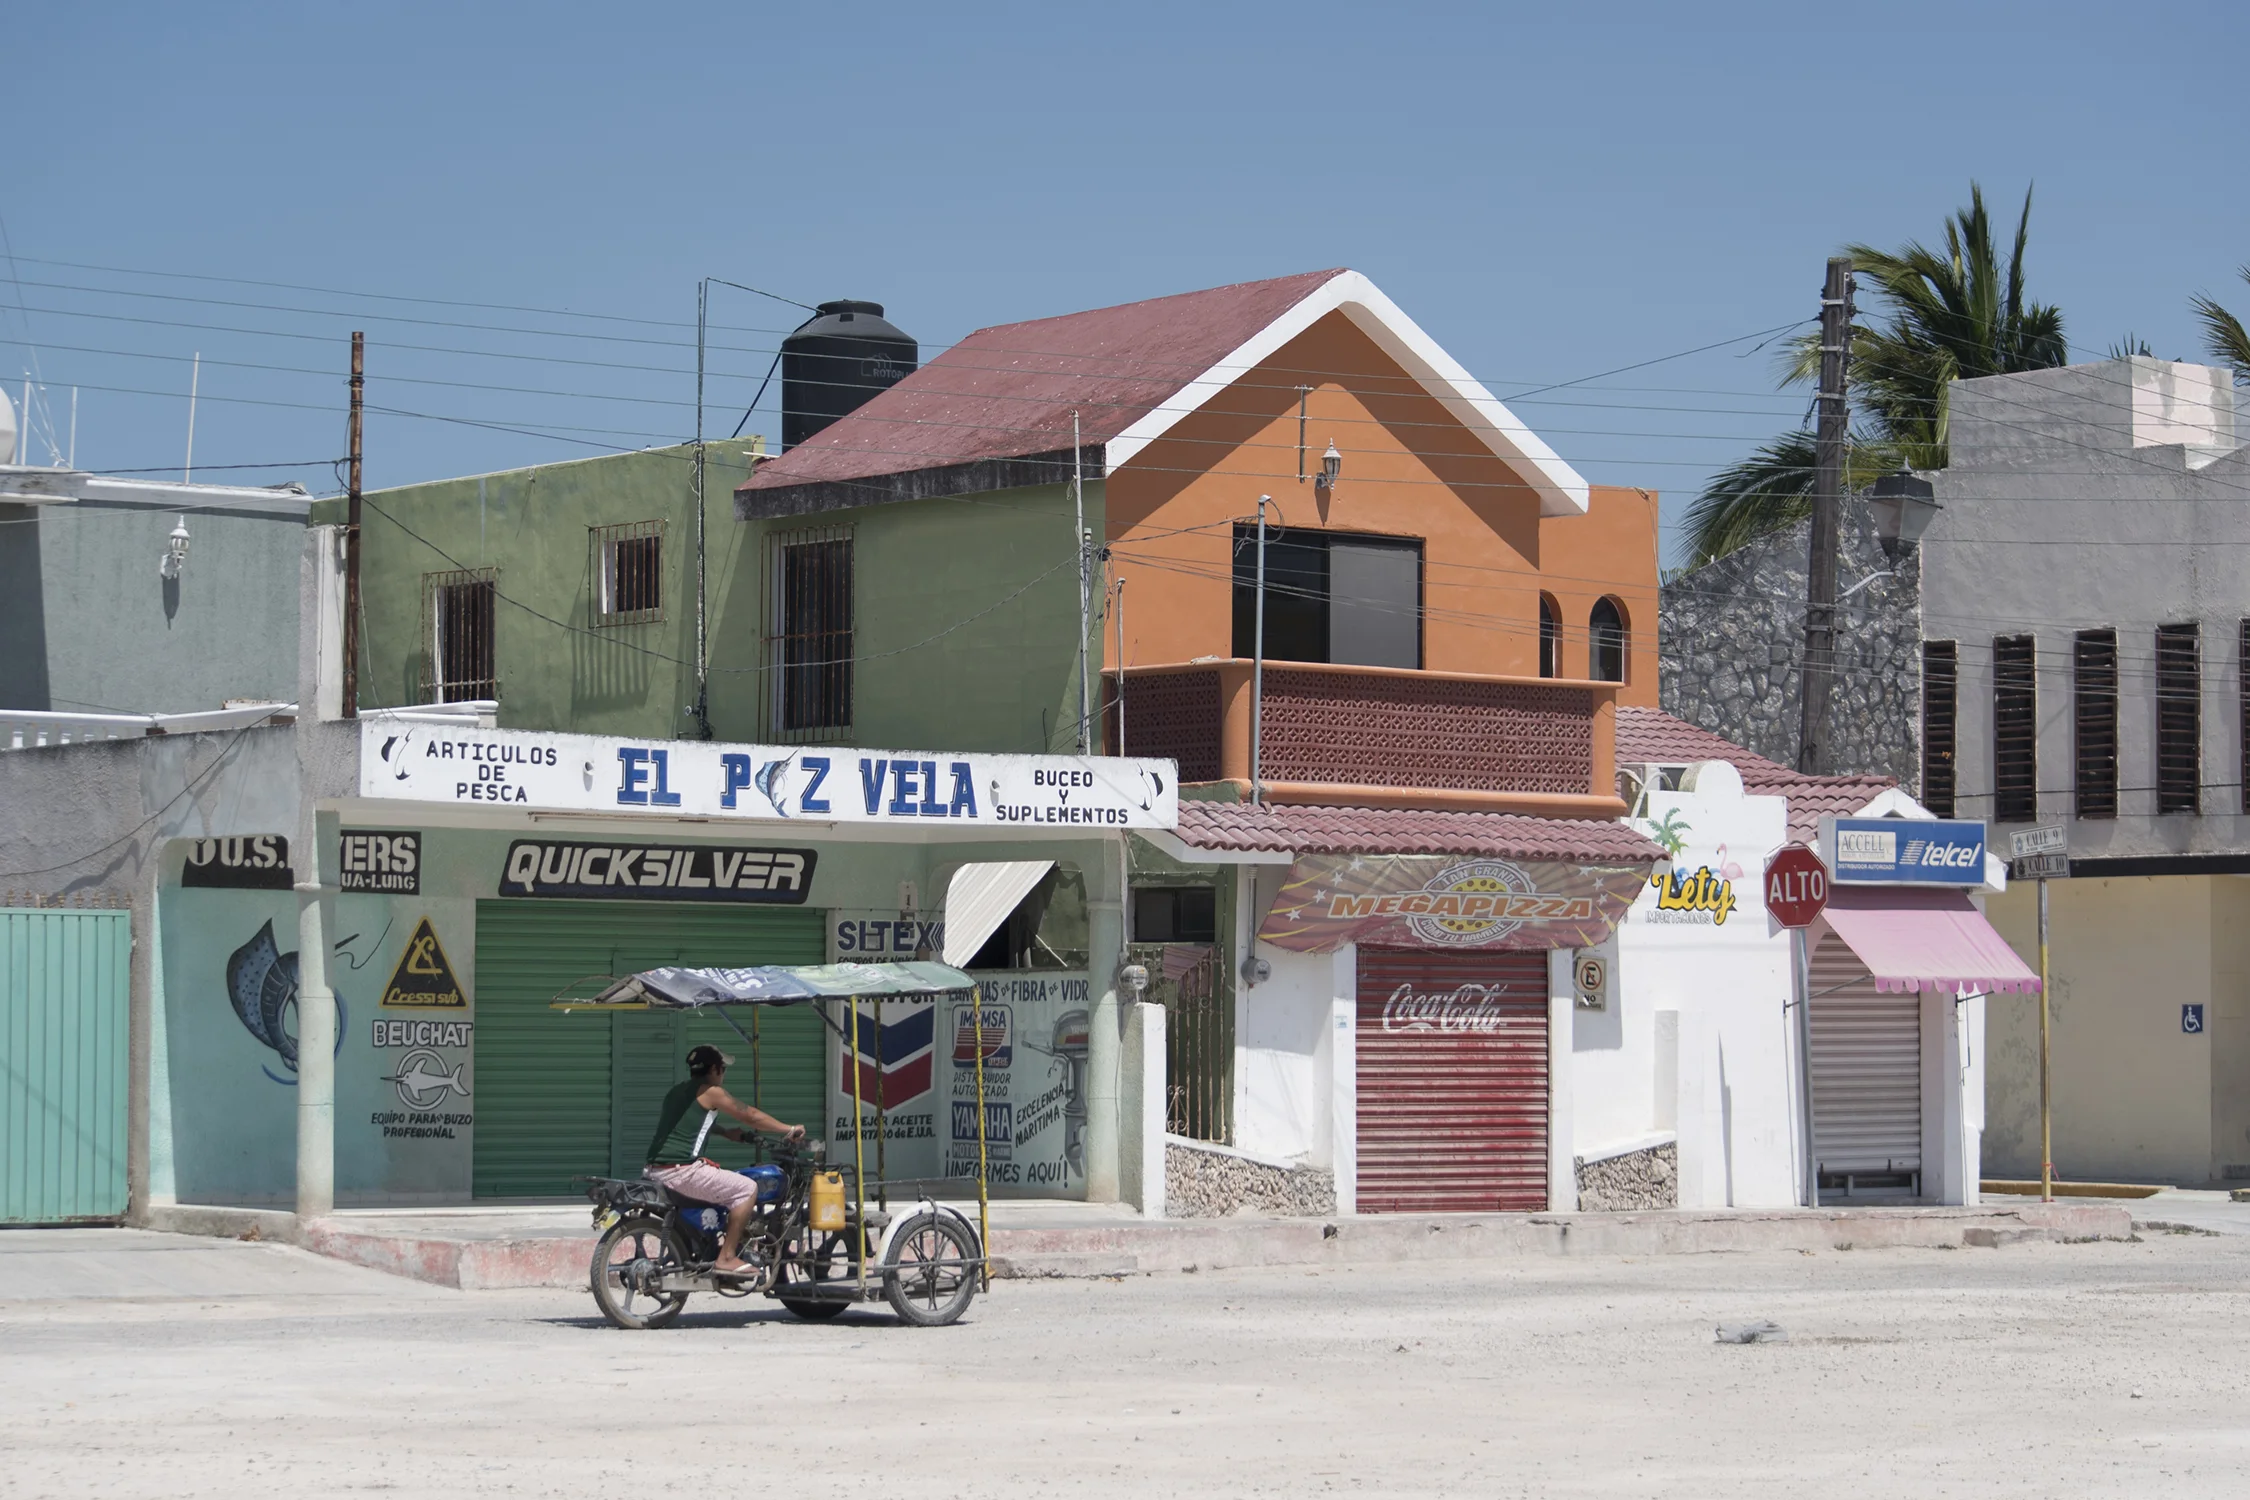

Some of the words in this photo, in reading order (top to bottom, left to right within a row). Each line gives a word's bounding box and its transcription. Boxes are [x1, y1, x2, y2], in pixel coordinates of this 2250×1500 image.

[426, 740, 557, 766] ARTICULOS
[478, 764, 505, 781] DE
[617, 747, 681, 807] EL
[859, 758, 978, 817] VELA
[1034, 770, 1093, 787] BUCEO
[456, 783, 528, 802] PESCA
[1058, 789, 1069, 804] Y
[996, 805, 1128, 824] SUPLEMENTOS
[1841, 834, 1884, 851] ACCELL
[2026, 829, 2049, 847] CALLE
[1921, 841, 1982, 867] telcel
[2029, 856, 2051, 871] CALLE
[2055, 856, 2065, 870] 10
[508, 844, 805, 892] QUICKSILVER
[1474, 866, 1522, 888] GRANDE
[1650, 865, 1736, 926] Lety
[1769, 869, 1824, 903] ALTO
[1327, 893, 1592, 919] MEGAPIZZA
[837, 920, 936, 951] SITEX
[1420, 918, 1444, 939] COMO
[1461, 921, 1507, 942] HAMBRE
[1011, 980, 1047, 1001] FIBRA
[960, 1010, 1006, 1027] IMMSA
[372, 1020, 473, 1047] BEUCHAT
[953, 1072, 1011, 1084] DISTRBUIDOR
[1016, 1083, 1064, 1125] EXCELENCIA
[409, 1113, 437, 1124] PARA
[443, 1113, 473, 1124] BUZO
[835, 1117, 849, 1128] EL
[892, 1114, 933, 1126] ACEITE
[953, 1105, 1011, 1139] YAMAHA
[1015, 1105, 1060, 1148] MARITIMA
[952, 1143, 992, 1157] MOTORS
